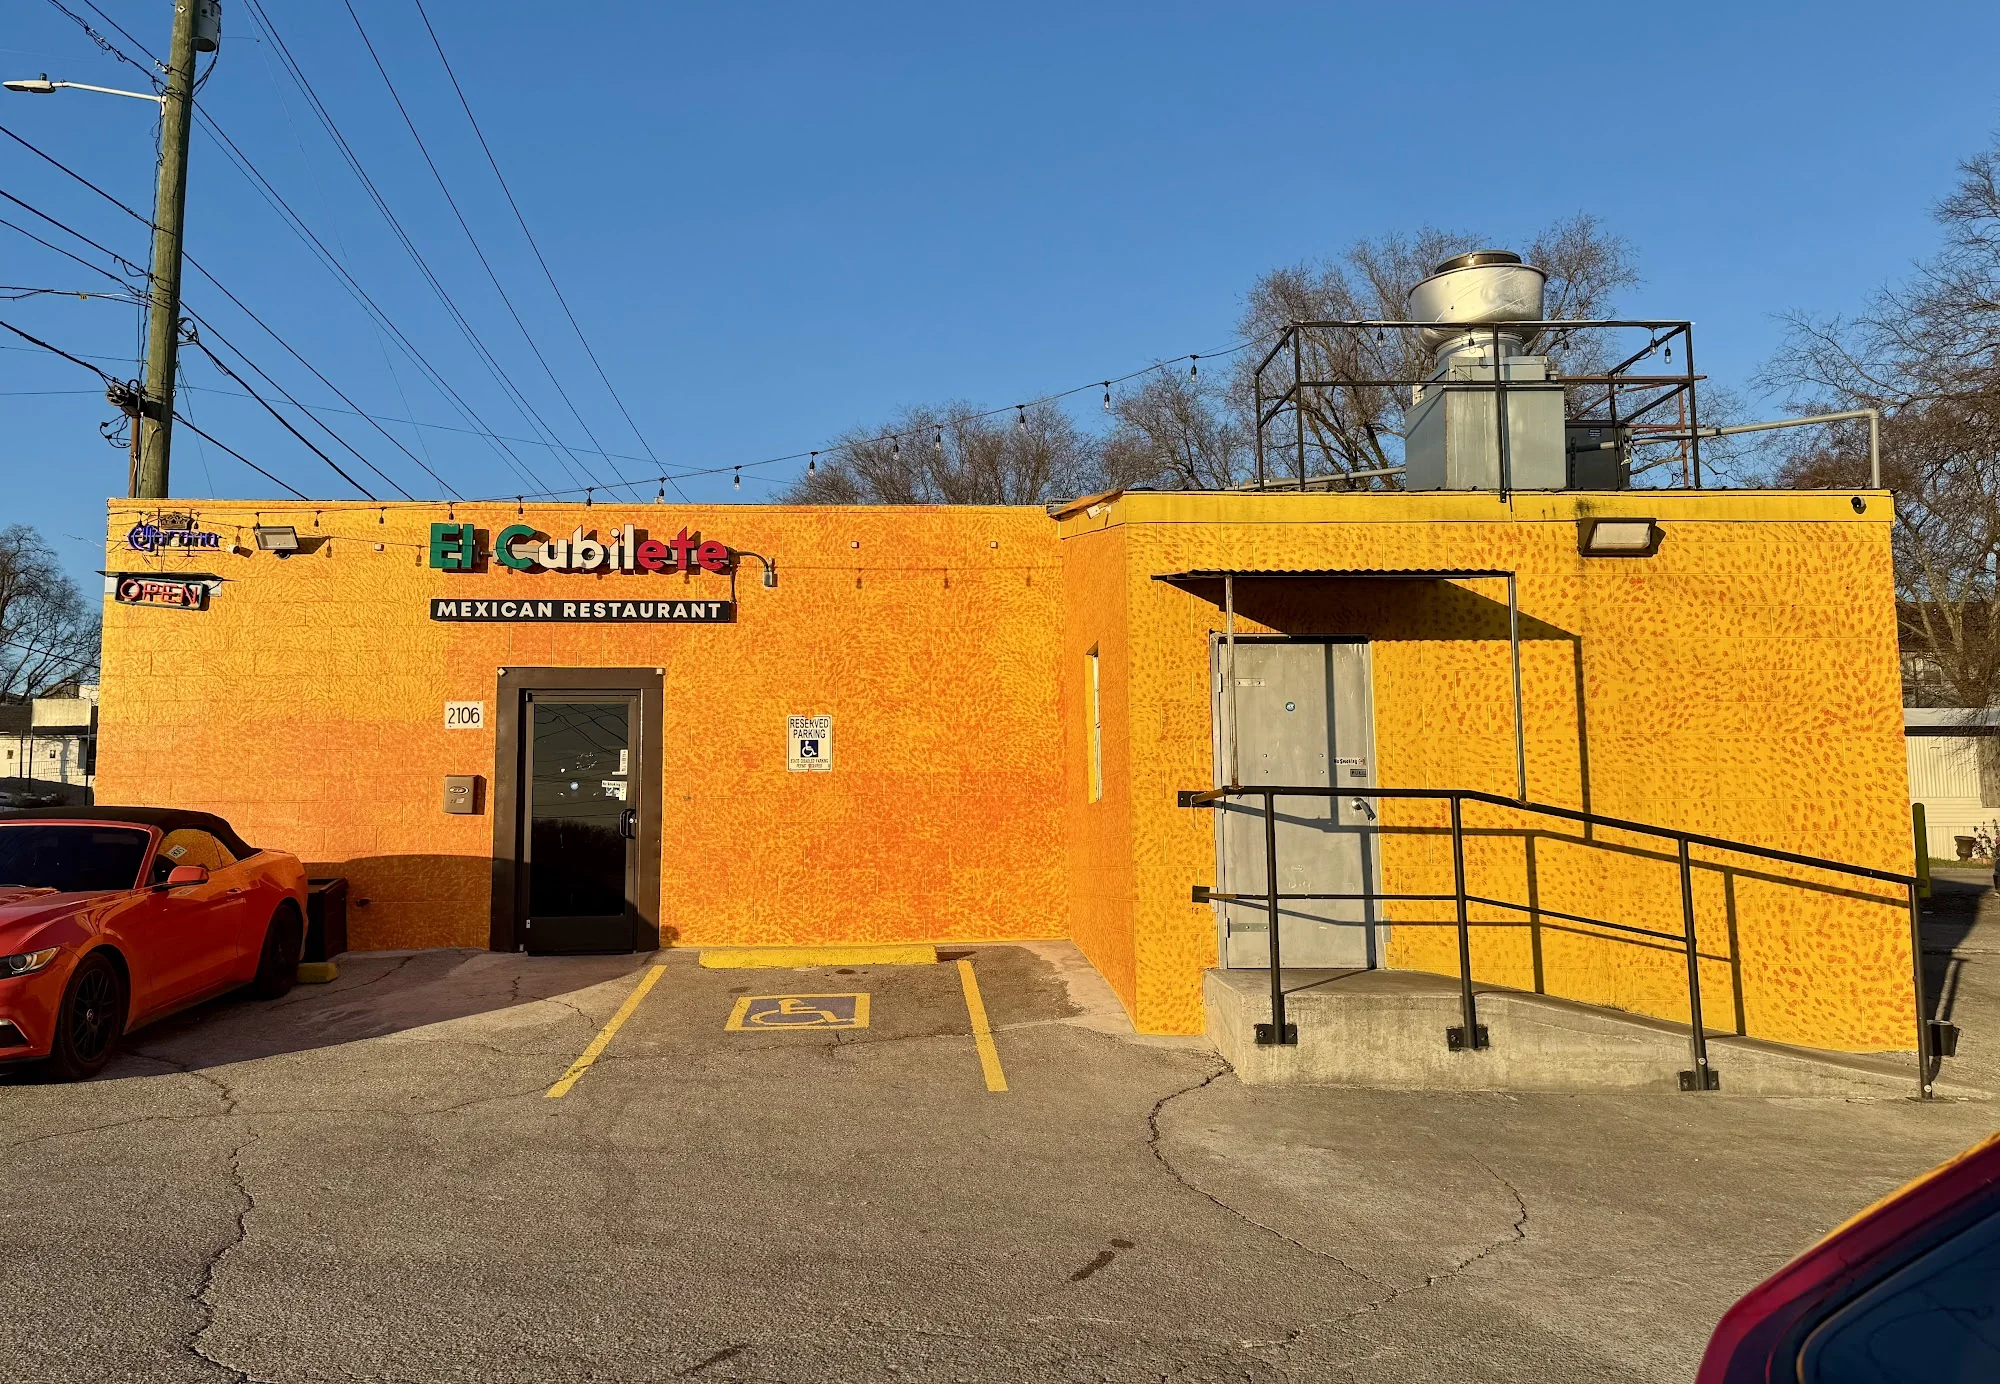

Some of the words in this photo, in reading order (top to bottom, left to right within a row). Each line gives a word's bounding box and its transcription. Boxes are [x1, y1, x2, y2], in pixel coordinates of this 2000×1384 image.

[127, 525, 220, 552] Corona
[430, 523, 474, 569] El
[495, 524, 727, 570] Cubilete
[120, 579, 198, 604] OPEN
[437, 602, 552, 617] MEXICAN
[563, 602, 721, 618] RESTAURANT
[448, 707, 480, 724] 2106
[790, 718, 829, 728] RESERVED
[793, 729, 826, 739] PARKING
